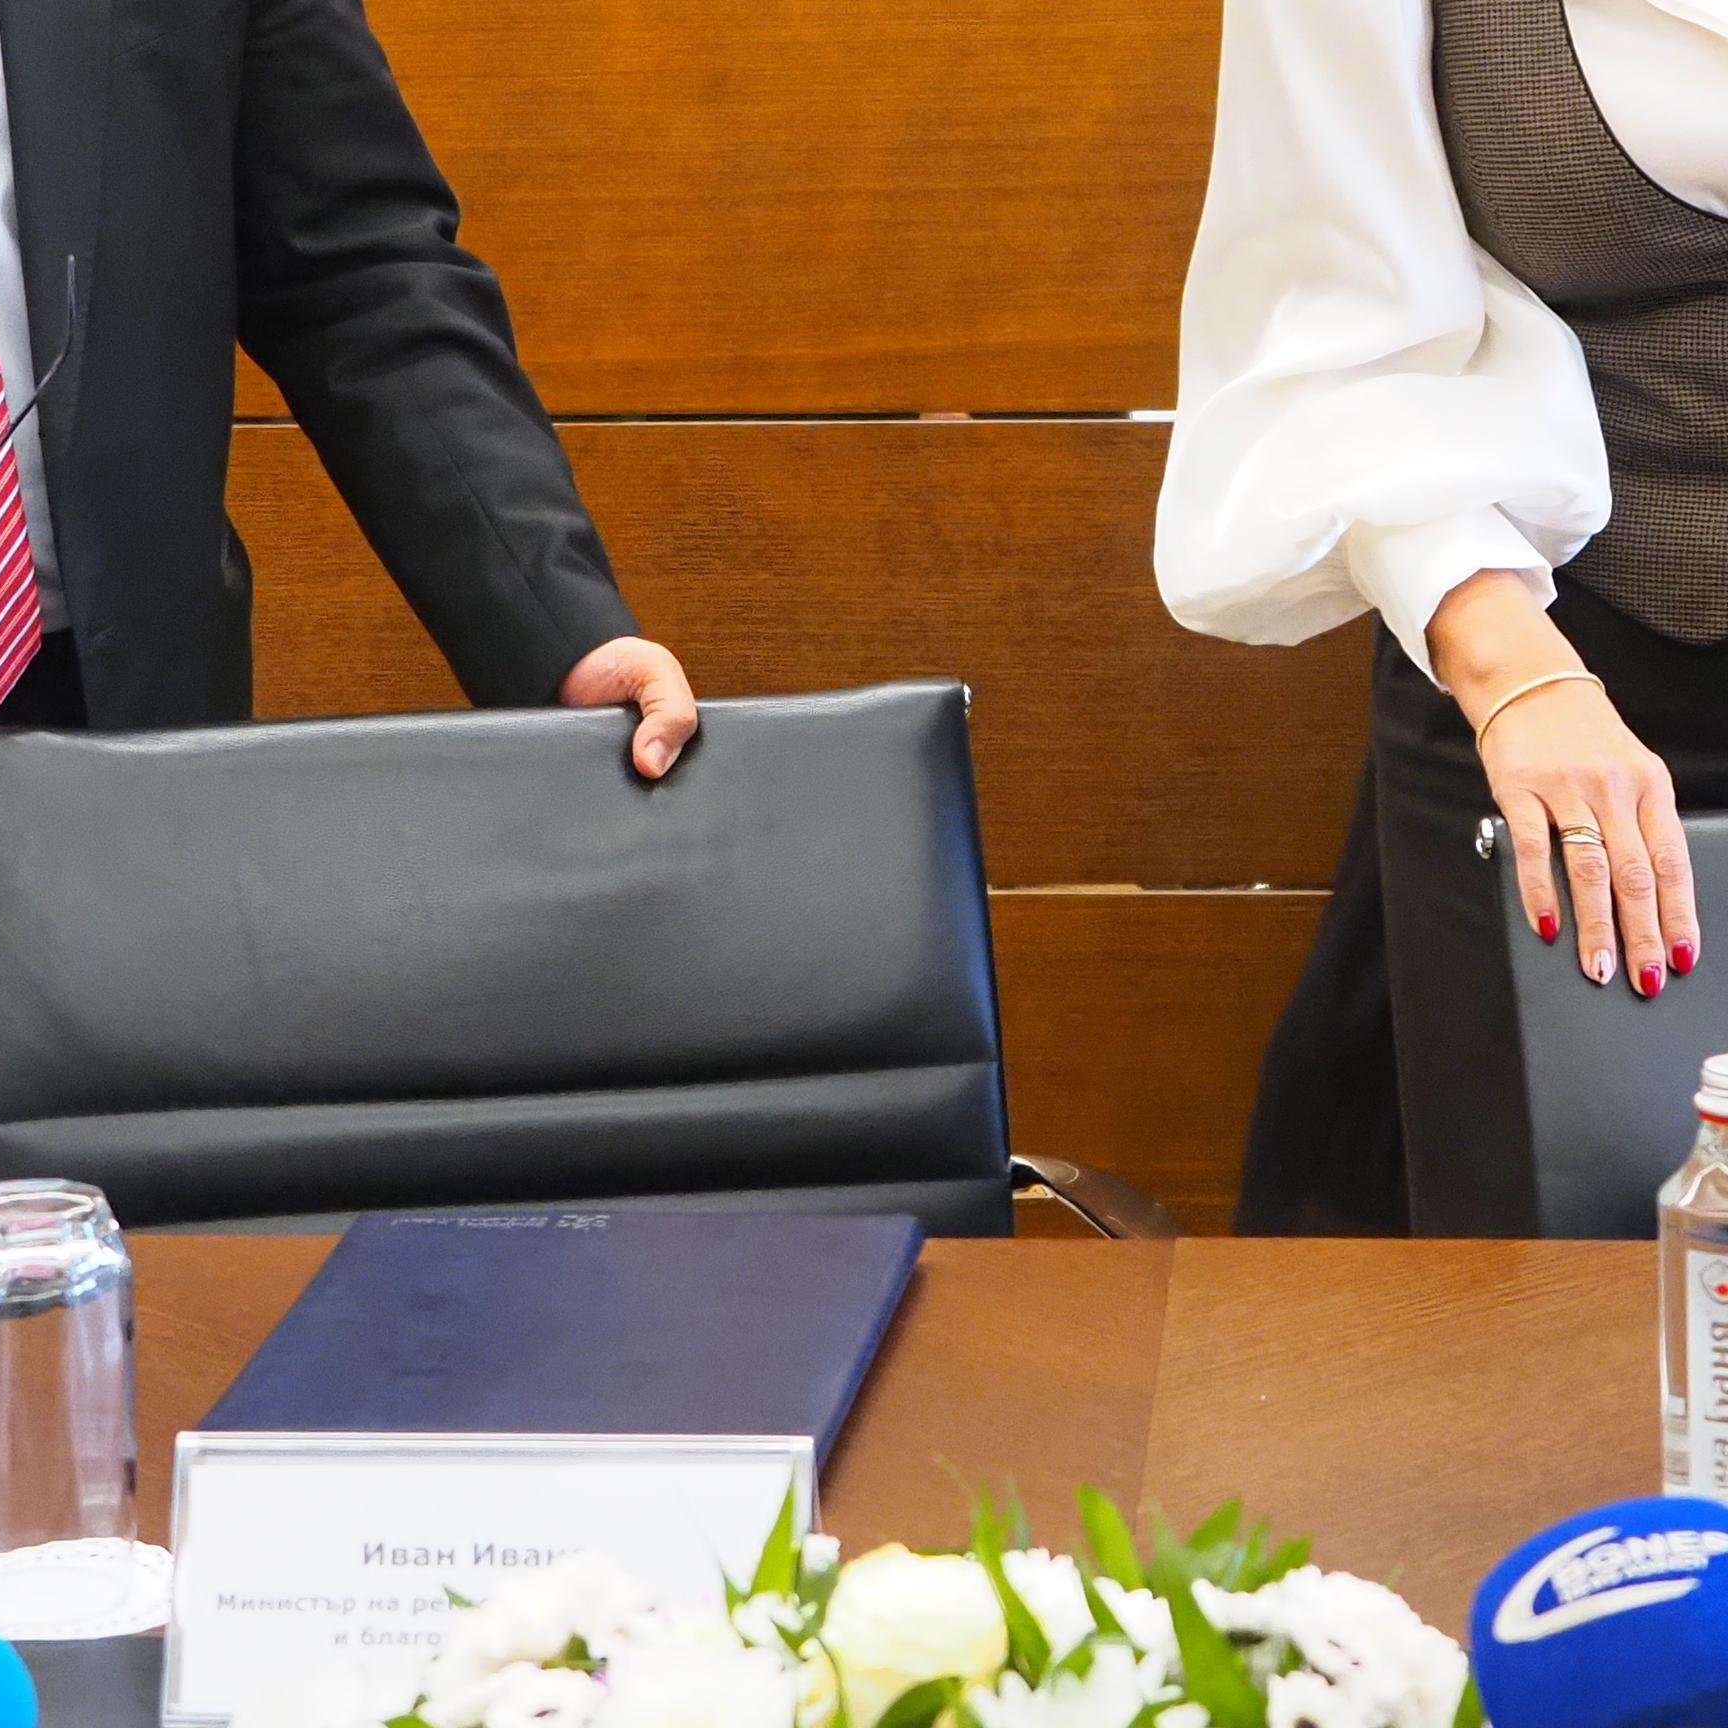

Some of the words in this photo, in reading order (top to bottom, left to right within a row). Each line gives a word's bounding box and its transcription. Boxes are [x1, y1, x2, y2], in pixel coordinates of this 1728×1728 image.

[362, 1541, 457, 1568] Иван
[472, 1541, 584, 1568] Иван
[216, 1592, 356, 1616] Министър
[368, 1596, 400, 1613] на
[333, 1632, 349, 1647] и
